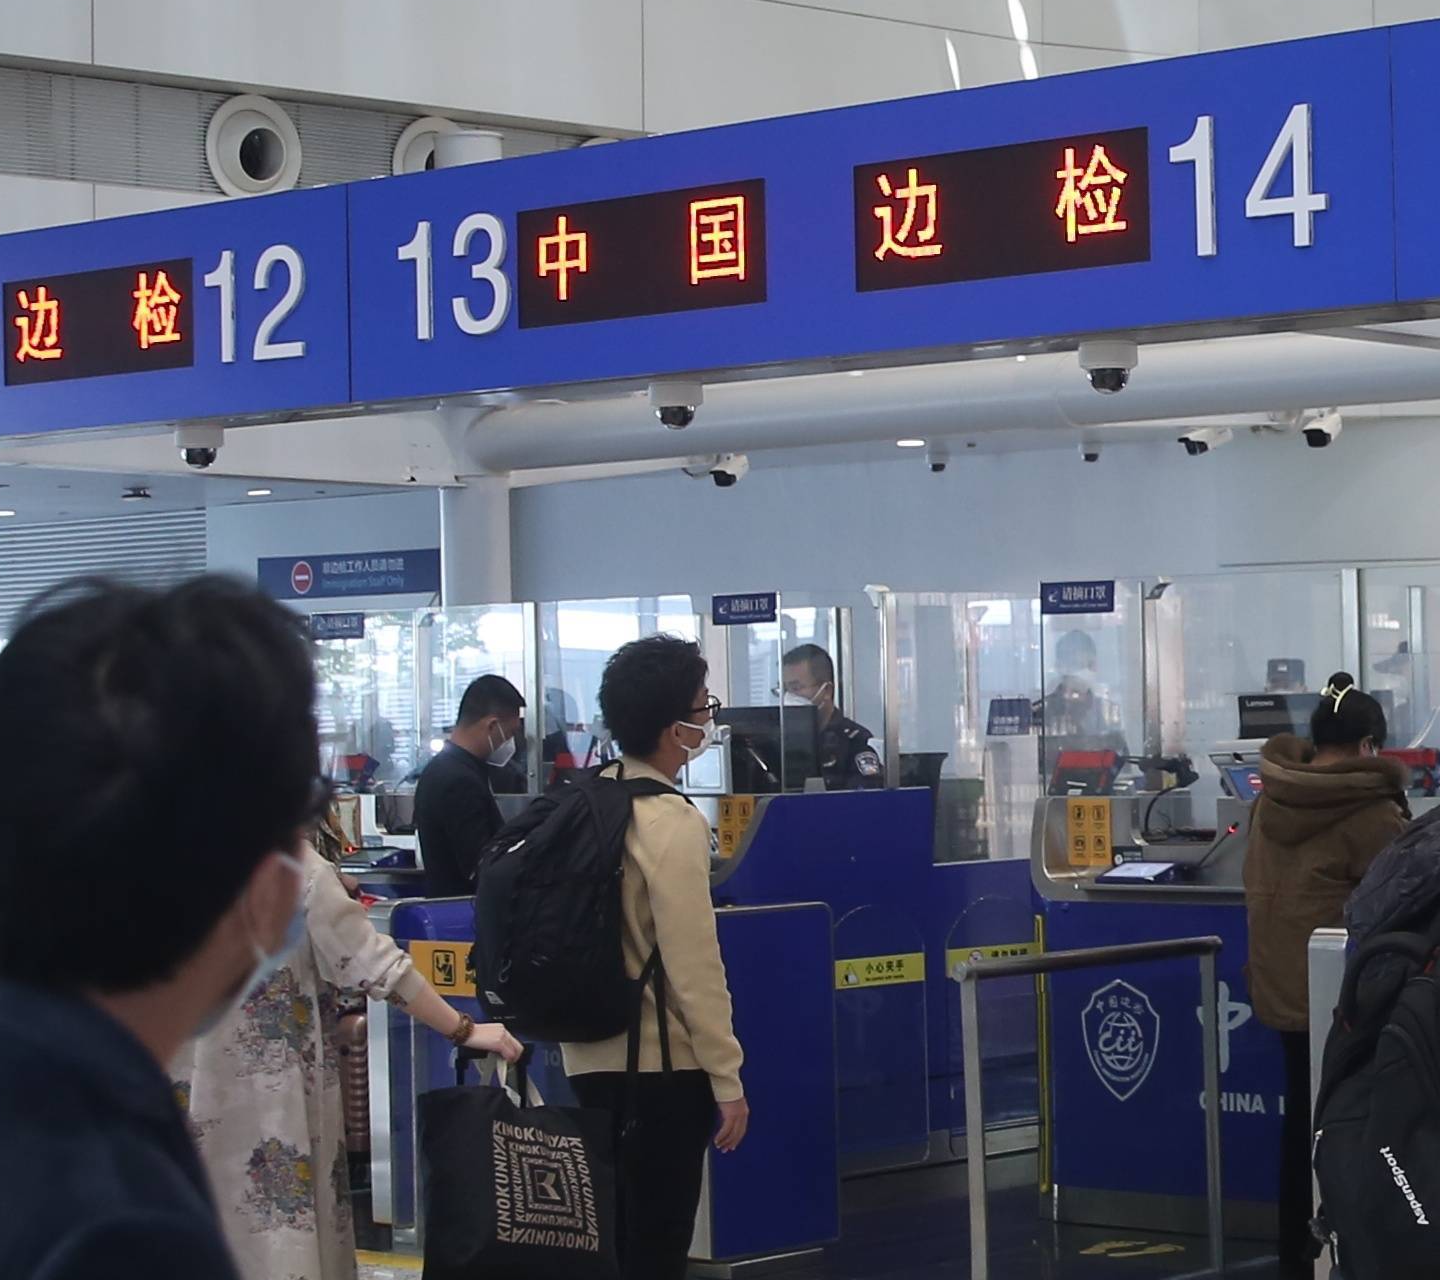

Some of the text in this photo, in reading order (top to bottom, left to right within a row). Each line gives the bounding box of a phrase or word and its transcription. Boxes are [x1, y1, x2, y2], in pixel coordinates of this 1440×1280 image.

[873, 143, 1129, 262] 边检
[1168, 103, 1328, 257] 14
[397, 213, 511, 340] 13
[536, 195, 746, 301] 中国
[13, 269, 182, 363] 边检
[203, 244, 306, 363] 12
[493, 1134, 511, 1242] KINOKUNIYA
[566, 1136, 599, 1237] KINOKUNIYA
[1379, 1146, 1430, 1225] AspenSport
